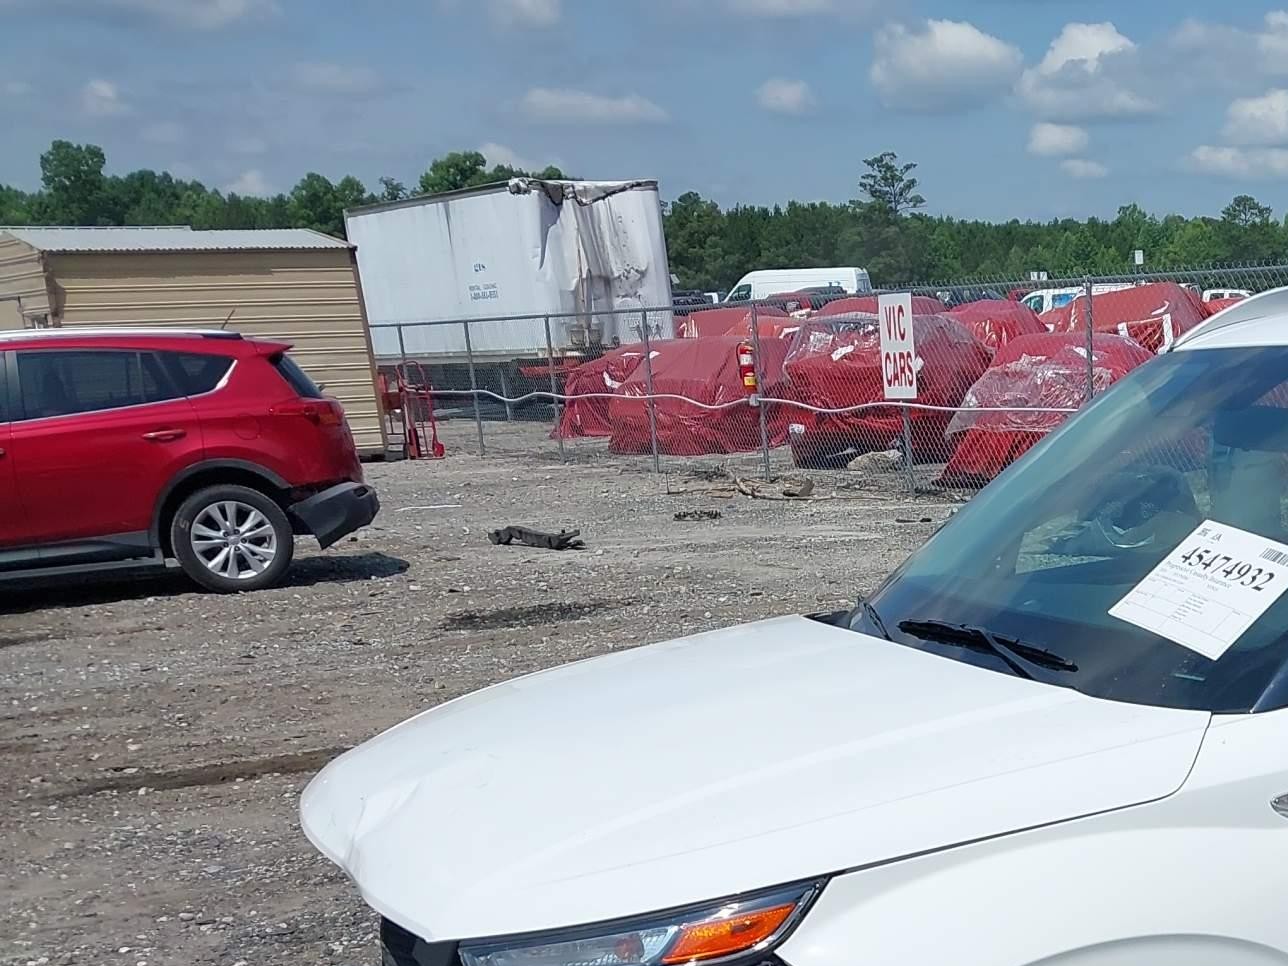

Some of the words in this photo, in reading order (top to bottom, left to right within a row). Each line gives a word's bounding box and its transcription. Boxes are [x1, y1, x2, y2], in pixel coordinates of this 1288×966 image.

[884, 305, 906, 341] VIC
[884, 351, 914, 387] CARS
[1180, 546, 1275, 592] 45474932
